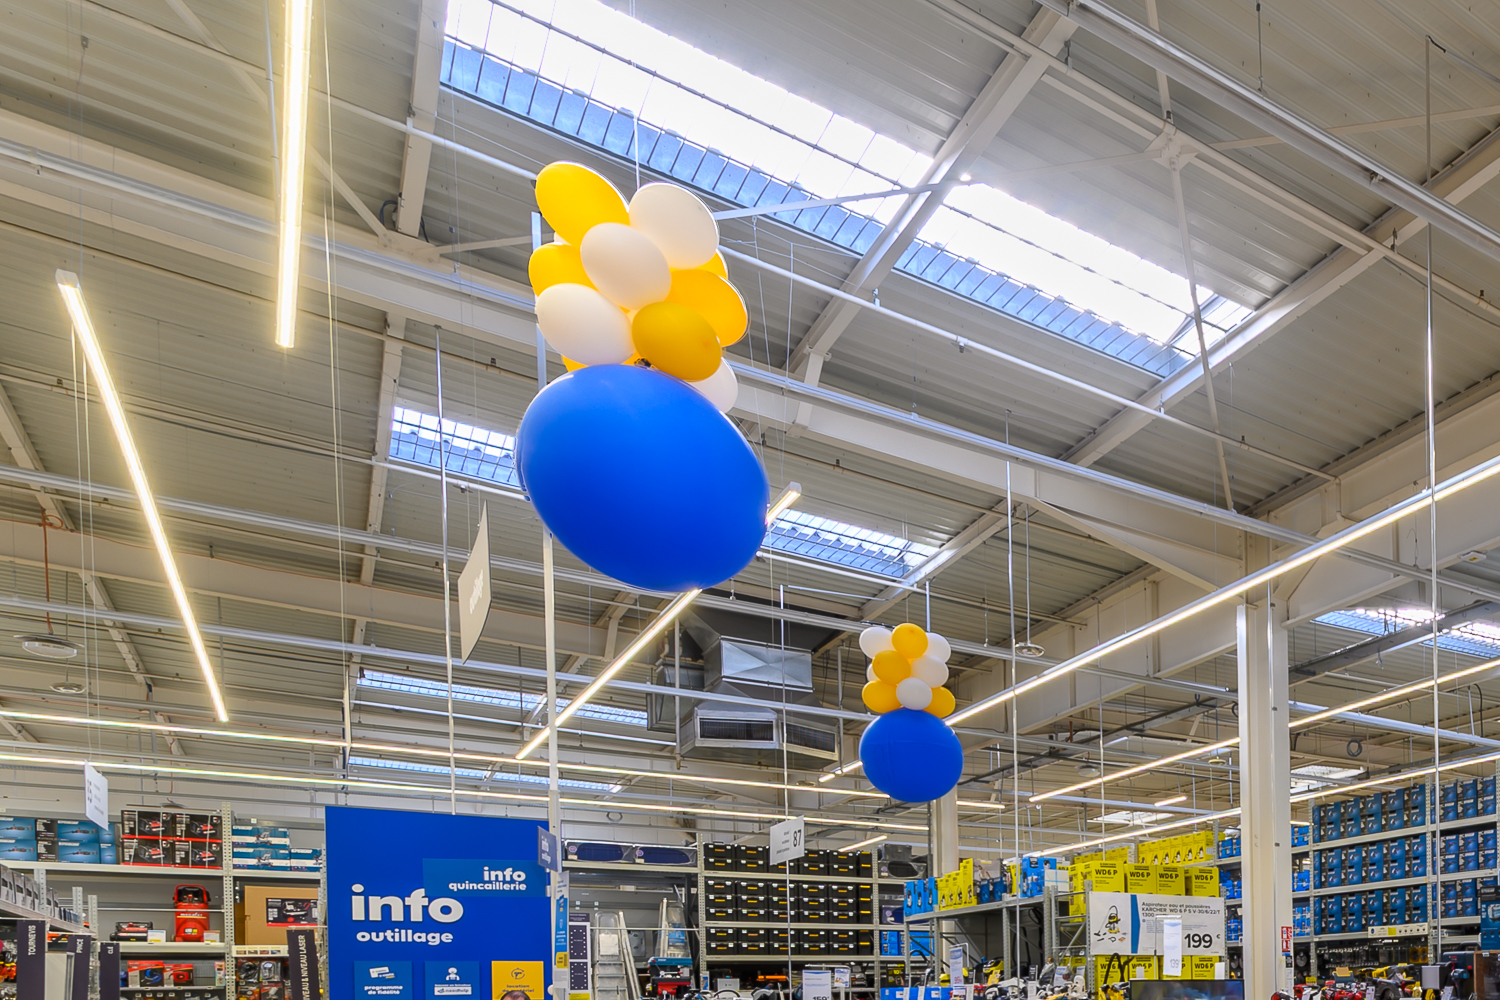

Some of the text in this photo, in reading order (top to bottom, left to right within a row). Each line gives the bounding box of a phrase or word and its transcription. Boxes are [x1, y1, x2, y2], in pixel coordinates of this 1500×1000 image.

[792, 829, 802, 848] 87
[483, 866, 526, 882] info
[449, 881, 526, 891] quincaillerie
[351, 883, 464, 923] info
[28, 925, 36, 956] TOURNEVIS
[298, 935, 306, 953] LASER
[356, 928, 454, 946] outillage
[1184, 933, 1213, 949] 199
[300, 953, 308, 977] NIVEAU
